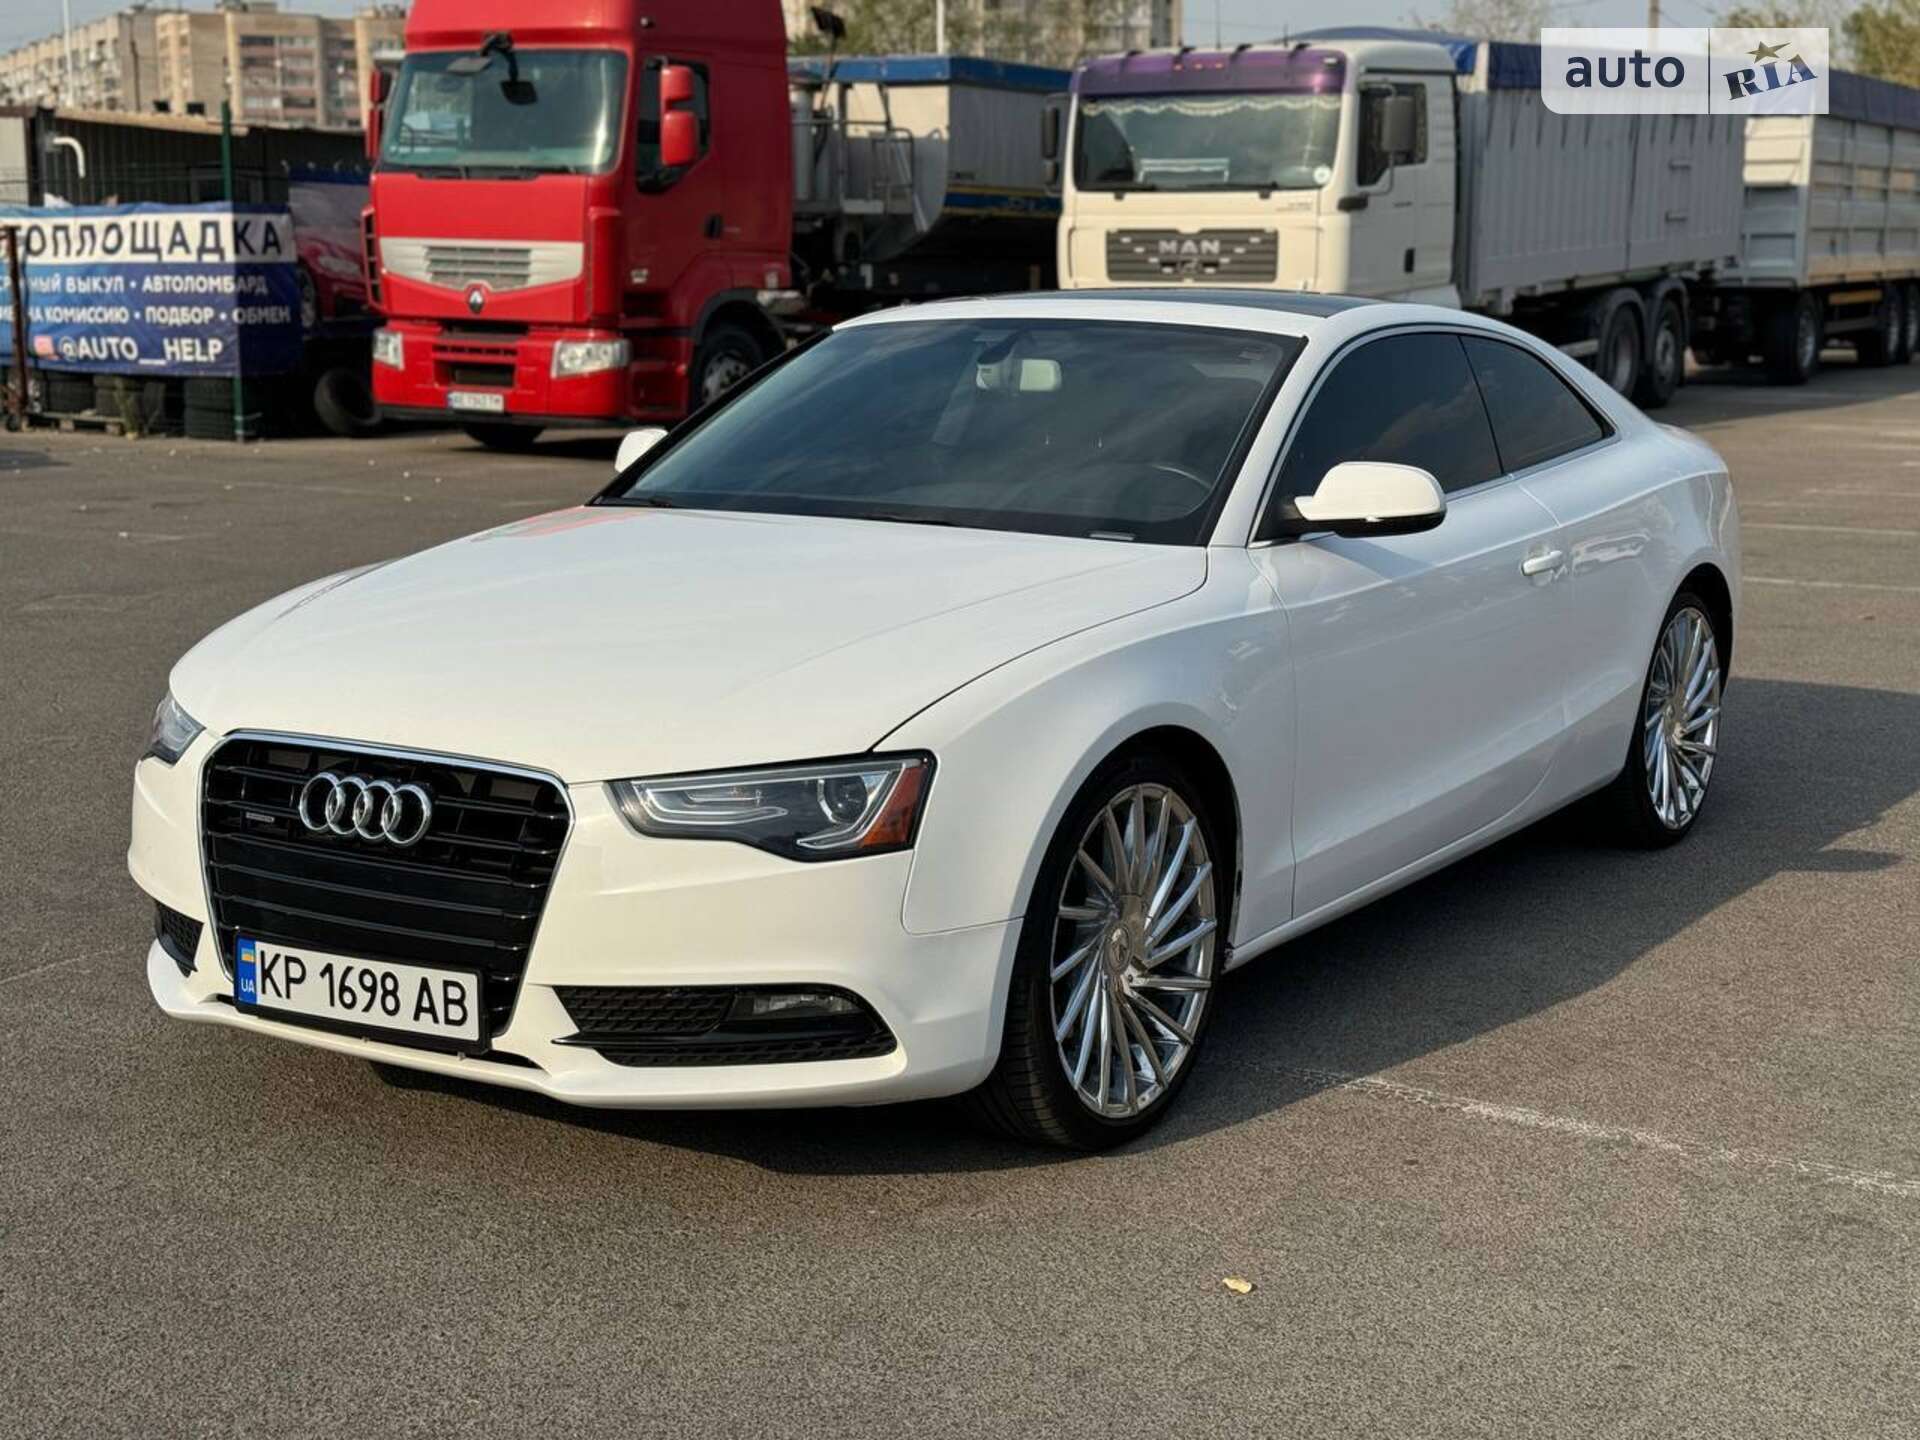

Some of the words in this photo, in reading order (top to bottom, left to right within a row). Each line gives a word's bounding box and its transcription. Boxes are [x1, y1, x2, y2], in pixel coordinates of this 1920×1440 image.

[1158, 240, 1221, 254] MAN
[65, 276, 125, 293] ВЫКУП
[142, 275, 268, 294] АВТОЛОМБАРД
[44, 306, 129, 323] КОМИССИЮ
[145, 306, 214, 326] ПОДБОР
[232, 306, 290, 323] ОБМЕН
[240, 978, 256, 993] UA
[260, 950, 307, 1000] KP
[319, 962, 402, 1017] 1698
[413, 976, 469, 1027] AB
